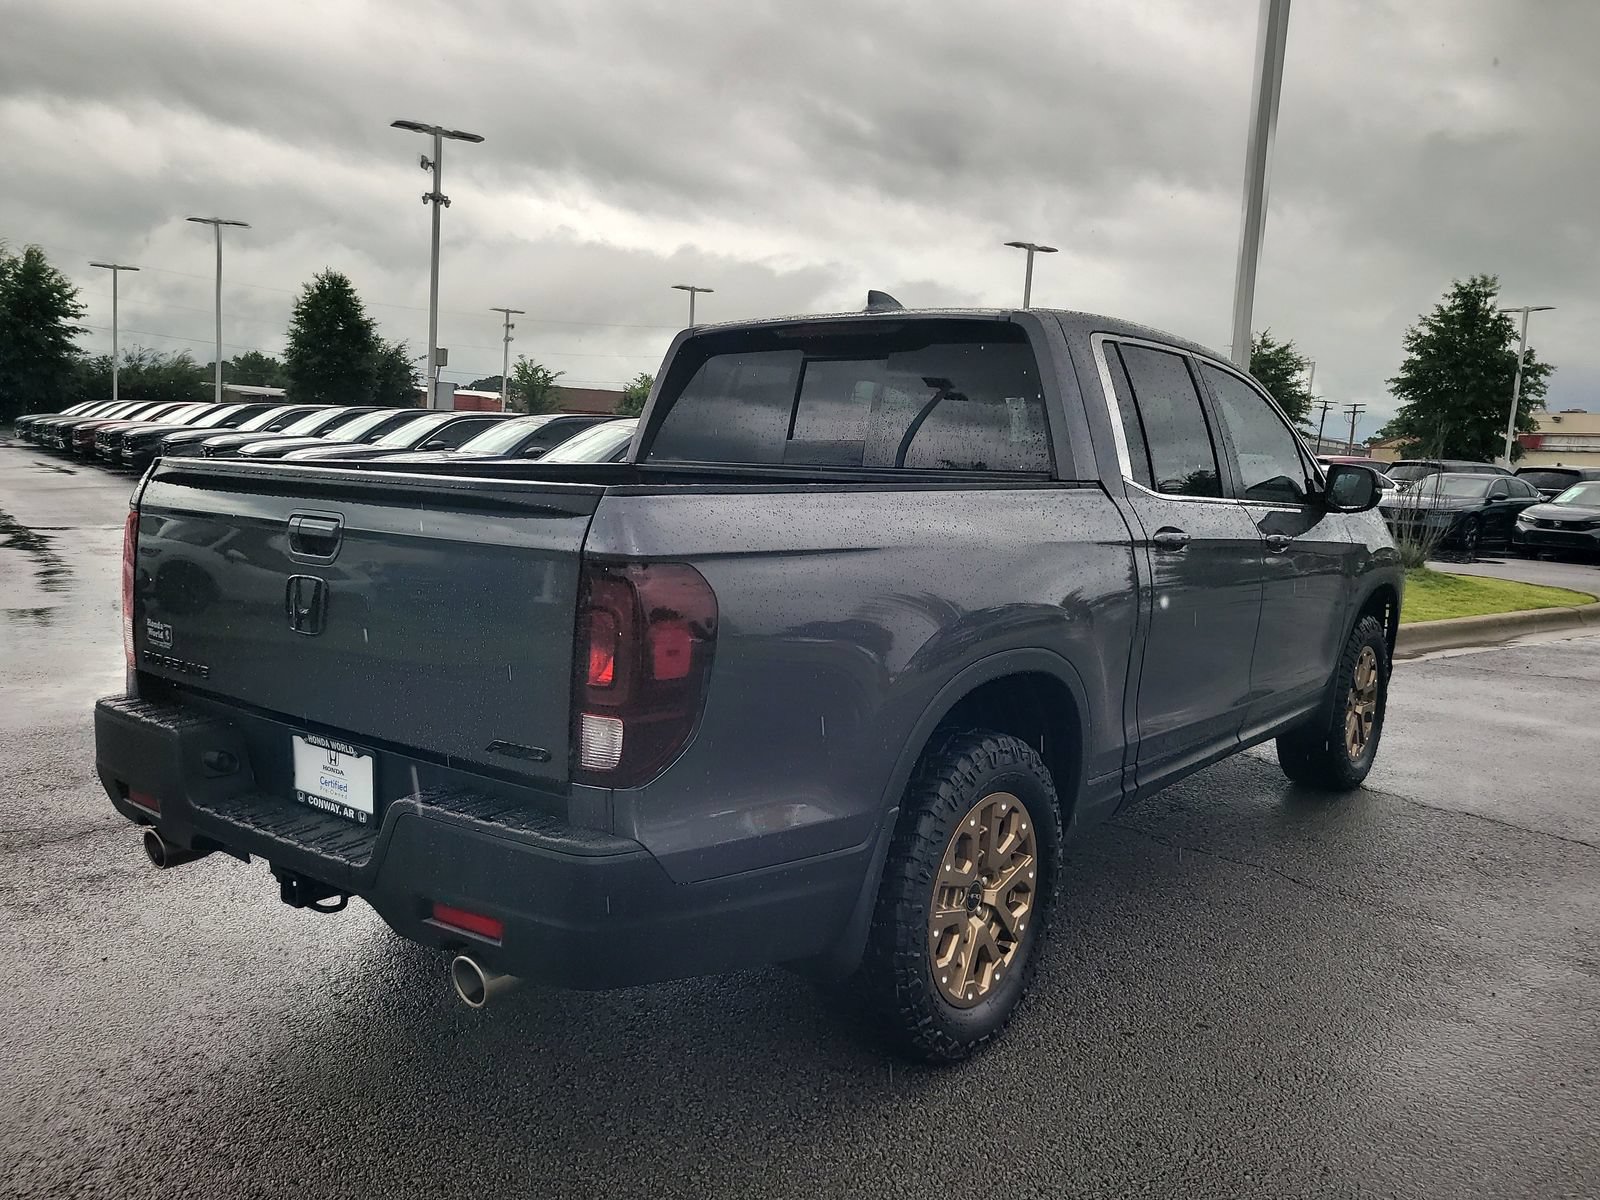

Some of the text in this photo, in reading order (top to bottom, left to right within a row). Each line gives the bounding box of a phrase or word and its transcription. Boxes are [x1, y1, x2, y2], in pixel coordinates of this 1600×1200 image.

[307, 734, 354, 754] HONDA WORLD
[322, 764, 345, 776] HONDA
[319, 776, 348, 793] Certified
[308, 795, 342, 816] CONWAY,
[343, 807, 354, 819] AR
